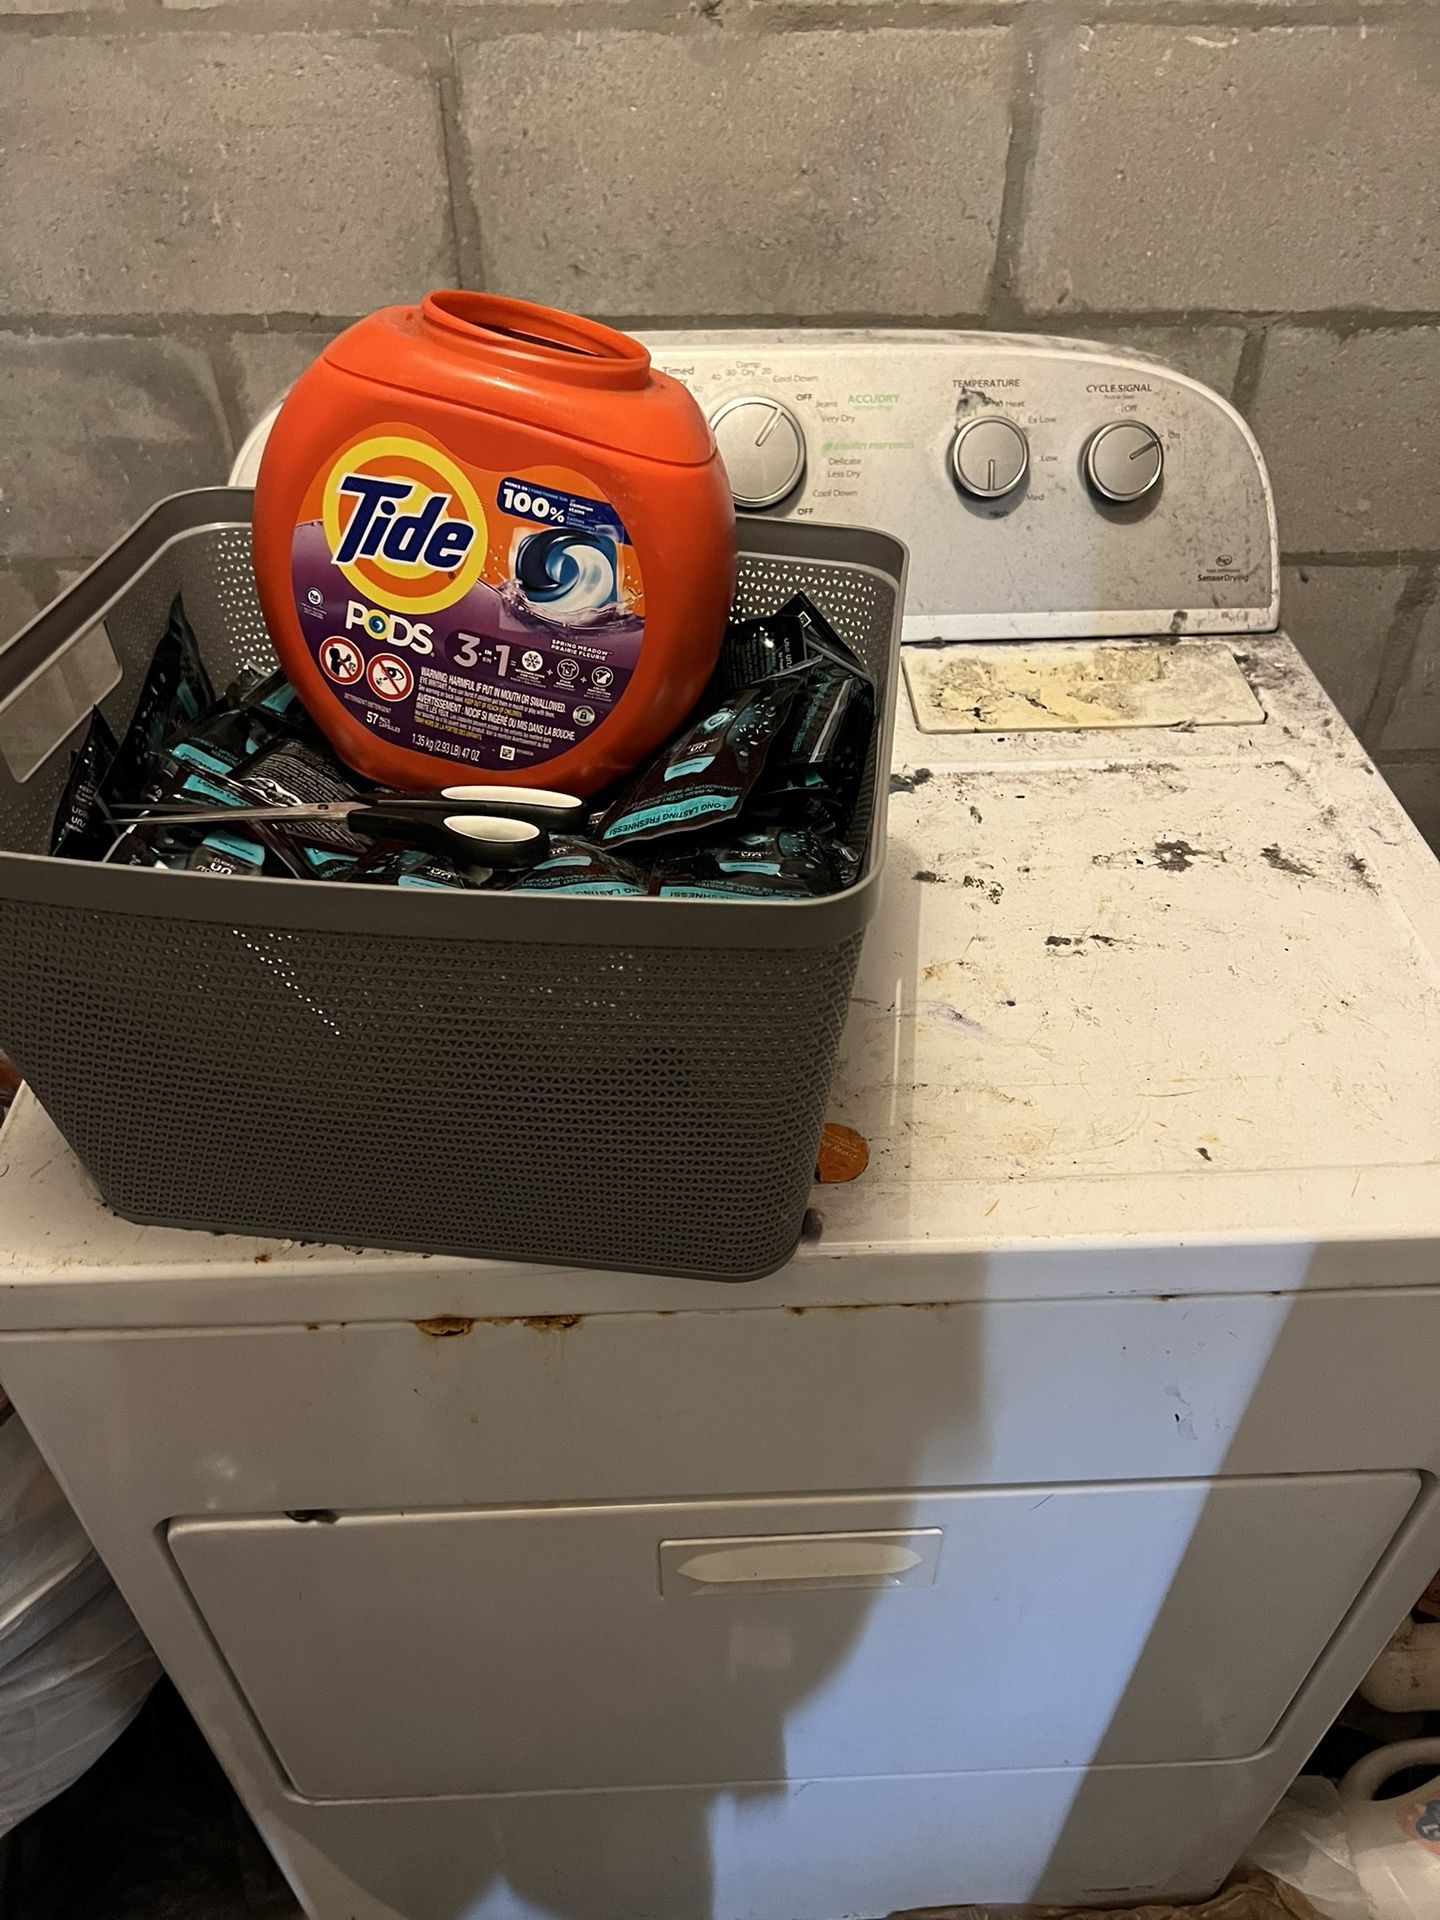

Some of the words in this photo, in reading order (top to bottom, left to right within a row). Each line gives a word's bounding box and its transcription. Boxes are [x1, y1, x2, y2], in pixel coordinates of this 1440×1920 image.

[662, 366, 695, 375] Timed
[793, 374, 819, 383] Down
[952, 379, 1021, 388] TEMPERATURE
[1086, 384, 1117, 393] CYCLE
[1118, 383, 1152, 392] SIGNAL
[796, 393, 814, 401] OFF
[848, 393, 900, 404] ACCUDRY
[1124, 404, 1138, 412] Off
[812, 489, 833, 498] Cool
[834, 489, 858, 498] Down
[1026, 493, 1045, 501] Med
[503, 488, 565, 523] 100%
[797, 508, 814, 516] OFF
[333, 474, 476, 570] Tide
[345, 600, 434, 655] PODS
[453, 632, 481, 668] 3
[495, 645, 511, 677] 1
[550, 644, 577, 655] PRAIRIE
[578, 649, 607, 661] FLEURIE
[551, 639, 577, 650] SPRING
[578, 644, 608, 656] MEADOW
[420, 666, 448, 682] WARNING:
[448, 674, 475, 690] HARMFUL
[476, 682, 481, 692] IF
[481, 683, 493, 695] PUT
[493, 687, 500, 697] IN
[500, 688, 520, 702] MOUTH
[521, 693, 529, 704] OR
[530, 695, 566, 713] SWALLOWED.
[366, 711, 380, 725] 57
[417, 692, 461, 713] AVERTISSEMENT
[464, 705, 480, 718] NOCIF
[481, 710, 487, 720] SI
[508, 716, 516, 728] OU
[516, 718, 528, 731] MIS
[528, 721, 543, 735] DANS
[544, 725, 551, 736] LA
[552, 726, 575, 741] BOUCHE.
[412, 733, 426, 747] 1.35
[425, 738, 434, 751] kg
[434, 739, 450, 755] (2.93
[450, 743, 462, 759] LB)
[461, 747, 470, 758] 47
[470, 750, 481, 762] OZ
[662, 804, 699, 820] LASTING
[701, 802, 727, 811] LONG
[609, 814, 661, 835] FRESHNESS!
